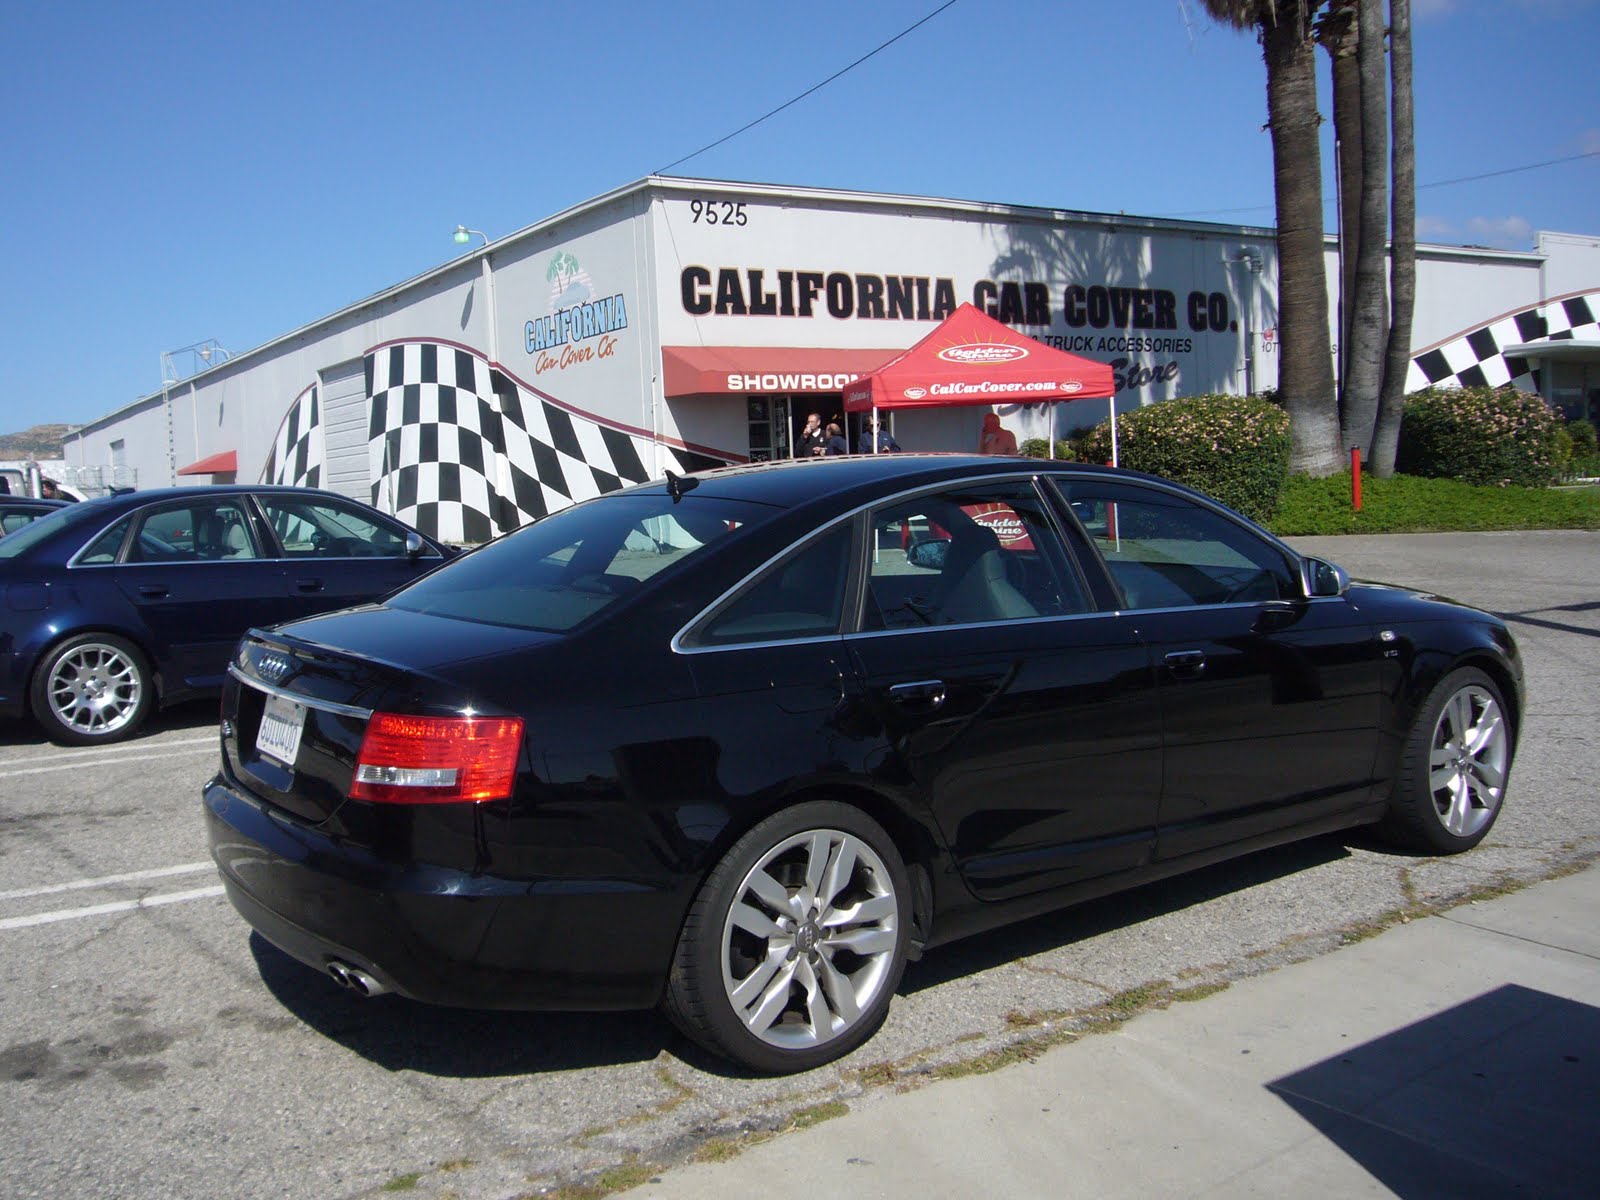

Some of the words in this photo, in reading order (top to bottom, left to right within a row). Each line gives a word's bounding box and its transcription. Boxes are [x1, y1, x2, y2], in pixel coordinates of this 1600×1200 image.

[690, 200, 748, 226] 9525
[680, 264, 957, 322] CALIFORNIA
[973, 279, 1050, 326] CAR
[1064, 285, 1177, 330] COVER
[1187, 291, 1238, 333] CO.
[524, 293, 628, 354] CALIFORNIA
[1045, 335, 1094, 351] TRUCK
[1097, 336, 1192, 353] ACCESSORIES
[535, 351, 559, 375] Car
[560, 345, 594, 369] Cover
[930, 381, 1057, 395] CalCarCover.com
[1109, 358, 1178, 393] Store
